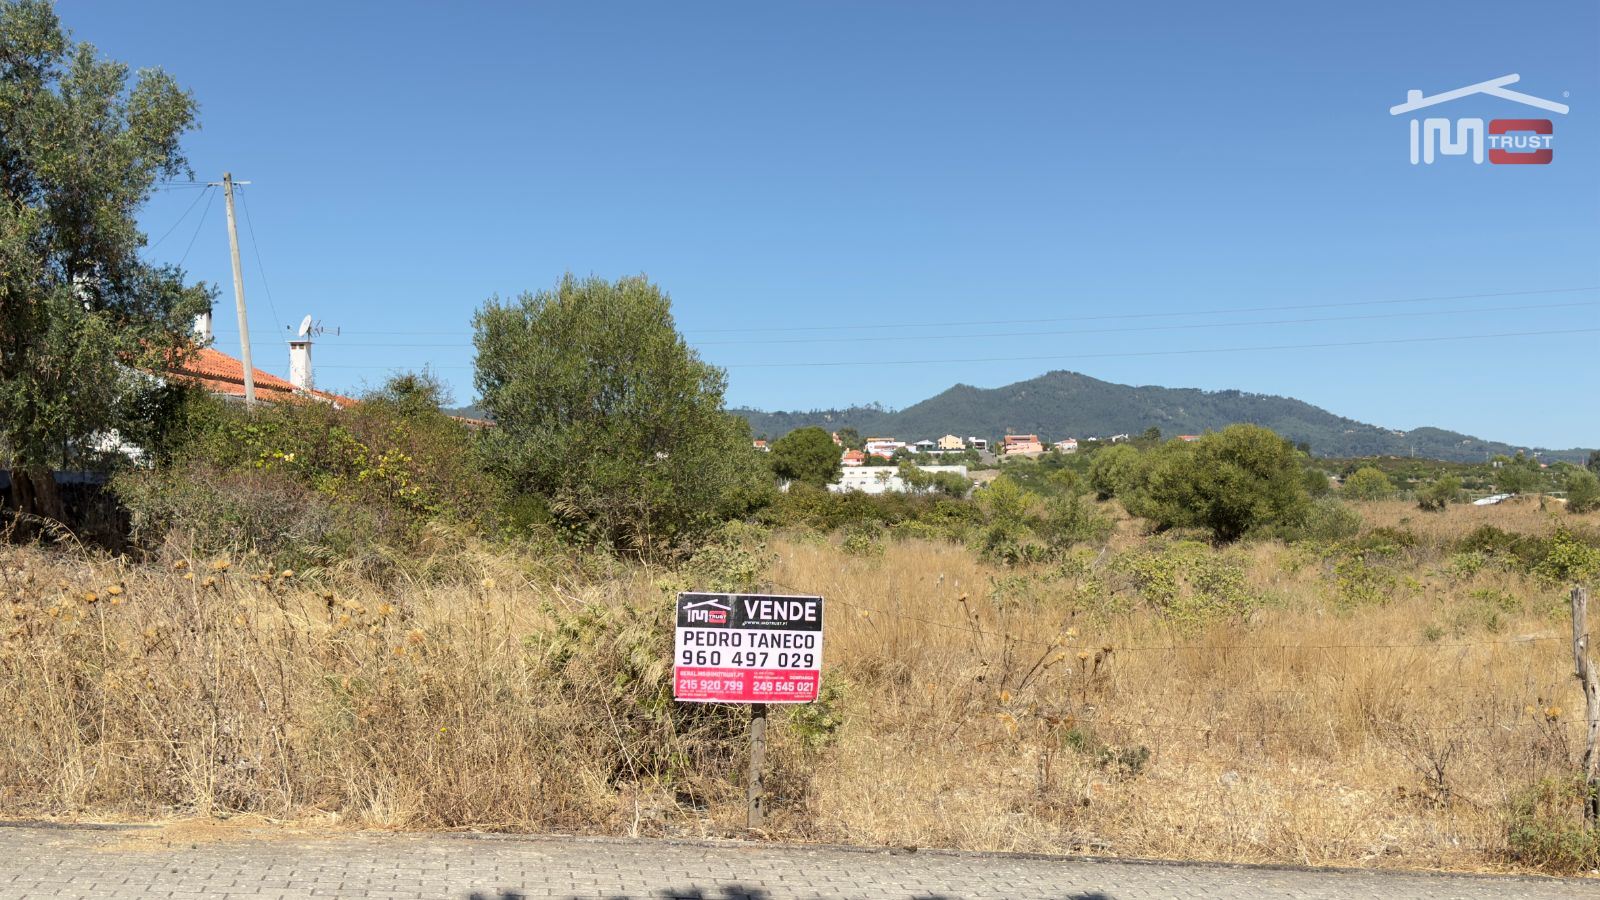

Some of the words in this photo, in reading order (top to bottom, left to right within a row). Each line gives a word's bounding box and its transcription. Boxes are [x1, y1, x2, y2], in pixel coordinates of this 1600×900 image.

[744, 600, 817, 621] VENDE
[684, 631, 742, 647] PEDRO
[748, 633, 815, 649] TANECO
[682, 650, 721, 666] 960
[731, 651, 769, 667] 497
[778, 652, 814, 668] 029
[680, 679, 698, 690] 215
[700, 680, 720, 690] 920
[724, 681, 743, 691] 799
[753, 682, 773, 692] 249
[796, 682, 814, 692] 021
